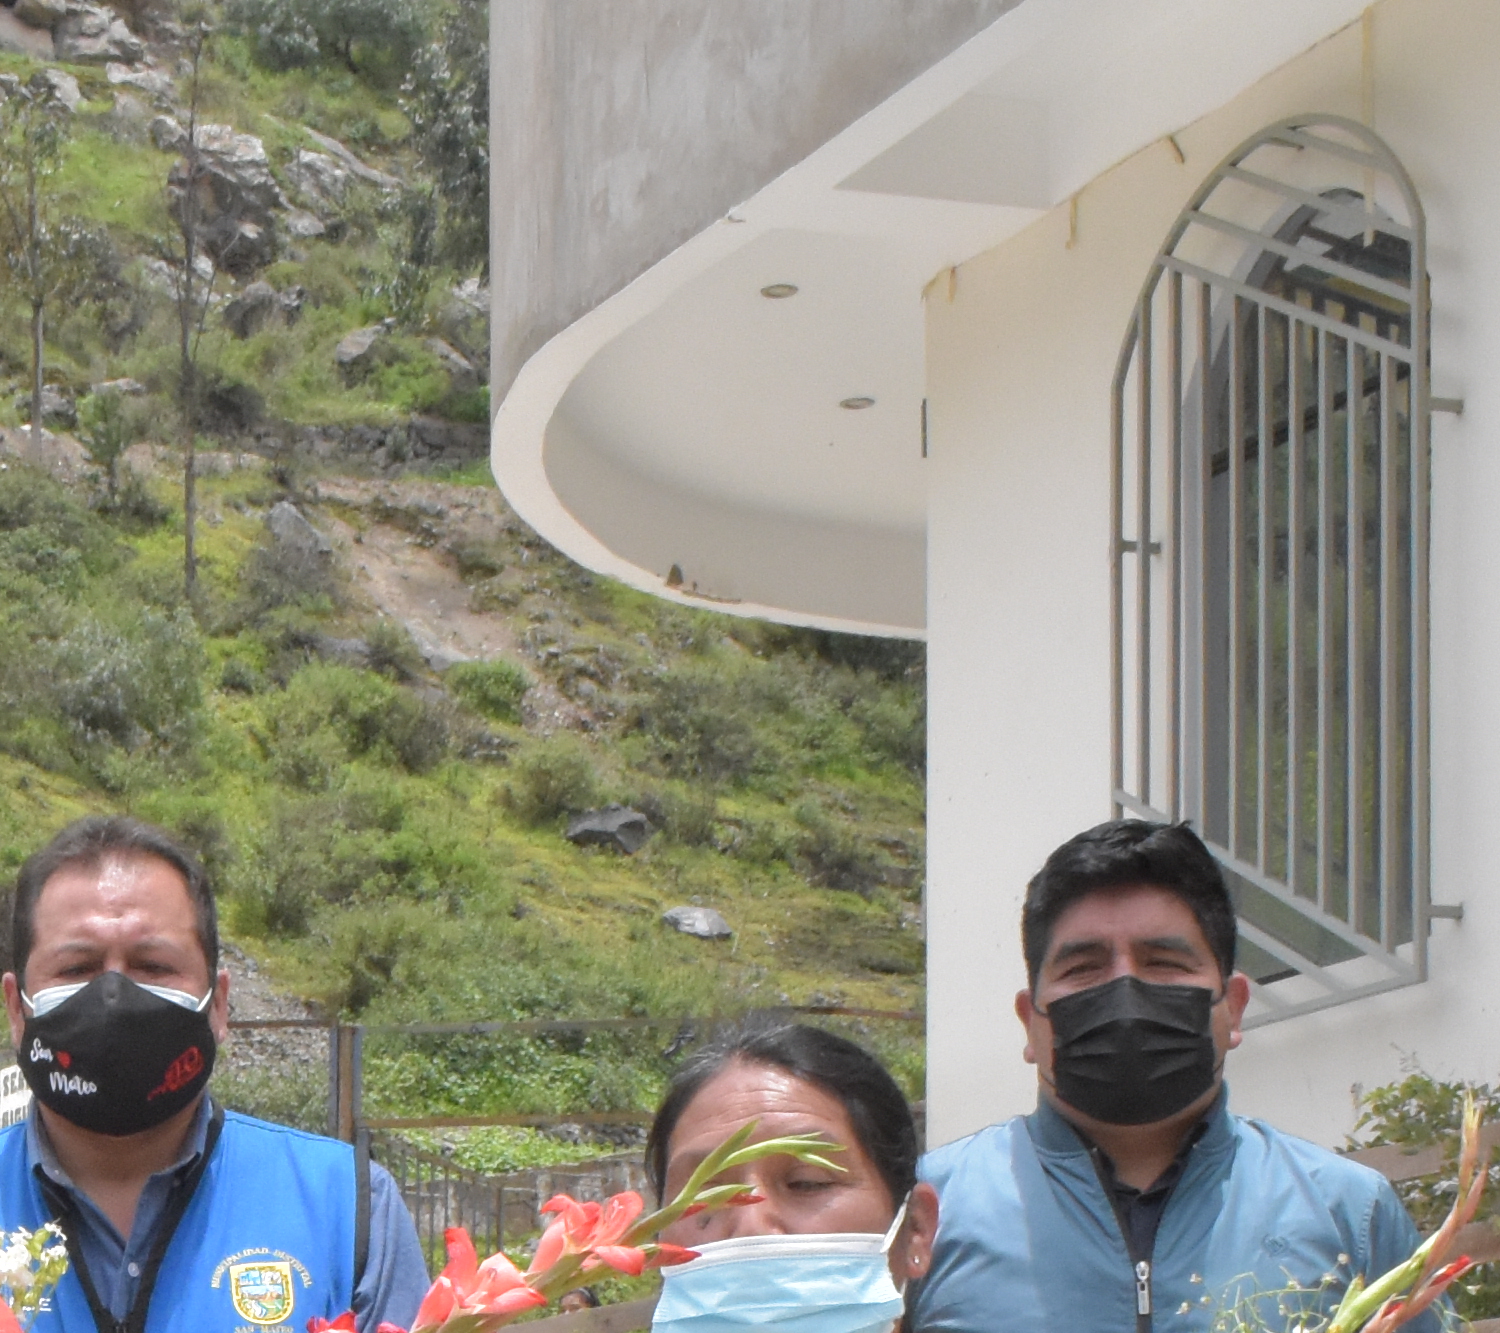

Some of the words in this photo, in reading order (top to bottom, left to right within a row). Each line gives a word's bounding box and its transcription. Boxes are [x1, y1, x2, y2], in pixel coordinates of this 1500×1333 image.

[30, 1037, 54, 1063] San
[50, 1071, 98, 1096] Mateo
[210, 1247, 269, 1289] MUNICIPALIDAD
[273, 1249, 312, 1289] DISTRITAL
